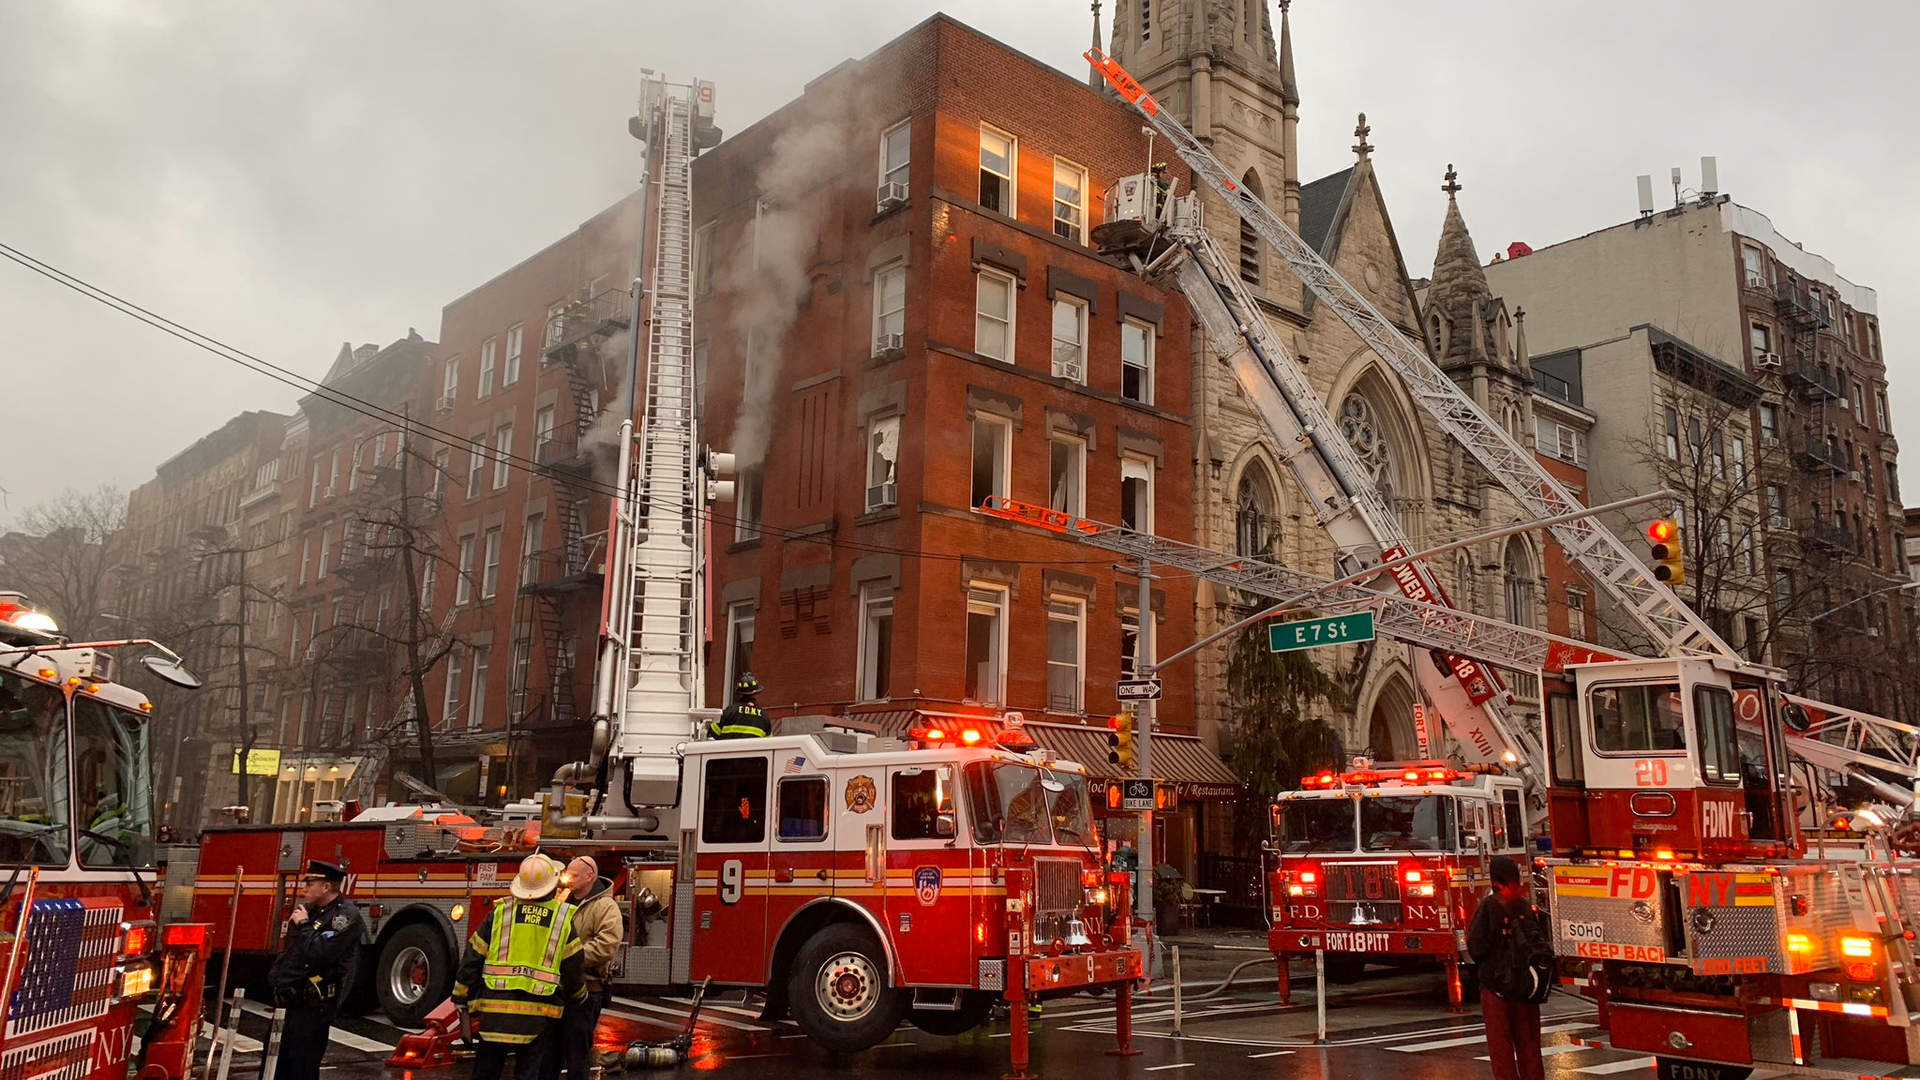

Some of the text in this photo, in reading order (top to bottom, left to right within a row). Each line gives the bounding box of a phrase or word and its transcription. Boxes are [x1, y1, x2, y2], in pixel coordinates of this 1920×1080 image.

[701, 87, 712, 102] 9
[1295, 622, 1347, 643] E 7 St
[1455, 659, 1475, 679] 18
[1120, 685, 1156, 694] ONE WAY
[1414, 705, 1426, 734] FORT
[1469, 727, 1494, 757] XVIII
[1635, 758, 1668, 786] 20
[1125, 799, 1152, 807] BIKE LANE
[1702, 801, 1735, 838] FDNY
[478, 863, 496, 872] FAST
[722, 859, 743, 903] 9
[1345, 866, 1382, 899] 18
[1610, 867, 1733, 908] FD NY
[521, 905, 549, 917] REHAB
[524, 914, 541, 924] MGR
[1569, 924, 1603, 938] SOHO
[1325, 931, 1390, 952] FORT 18 PITT
[1577, 941, 1619, 959] KEEP
[1087, 955, 1095, 983] 9
[1702, 956, 1768, 975] 200 FEET
[1670, 1064, 1722, 1080] FDNY
